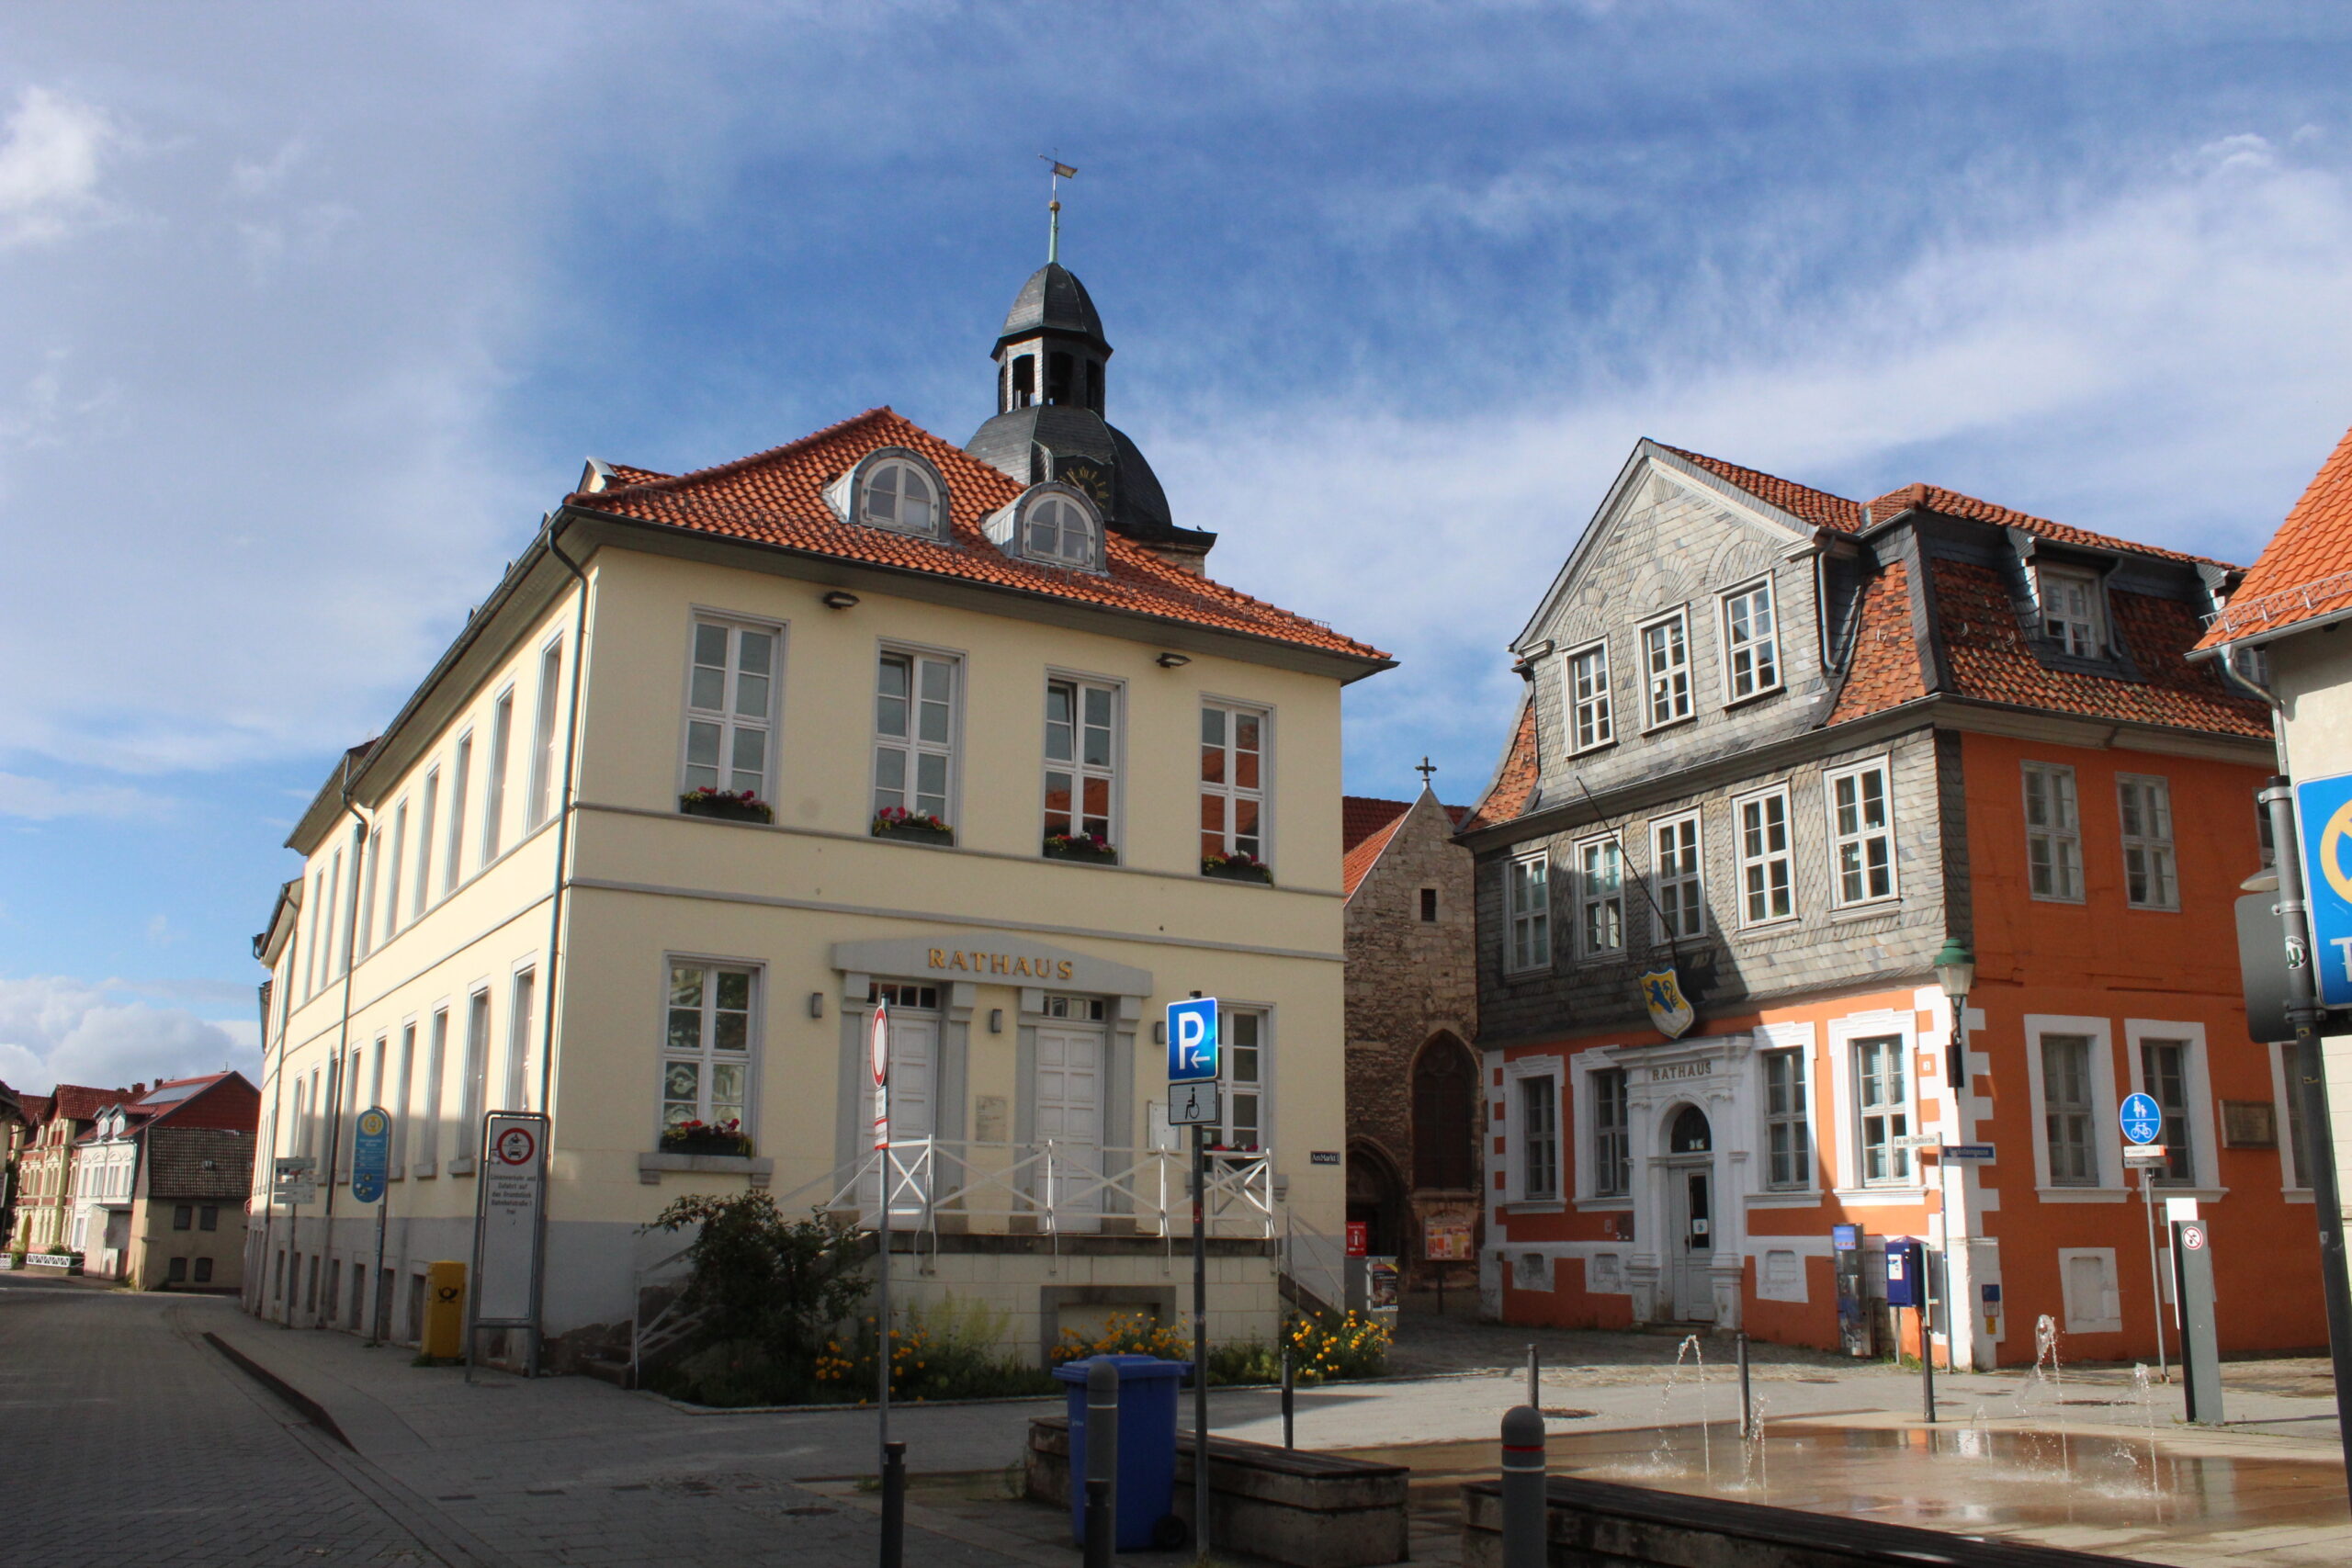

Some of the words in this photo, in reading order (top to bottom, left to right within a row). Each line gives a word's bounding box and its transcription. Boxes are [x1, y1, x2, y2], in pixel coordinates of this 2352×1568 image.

[928, 948, 1073, 979] RATHAUS
[1179, 1011, 1204, 1070] P
[1652, 1059, 1712, 1080] RATHAUS
[1321, 1153, 1337, 1162] Markt
